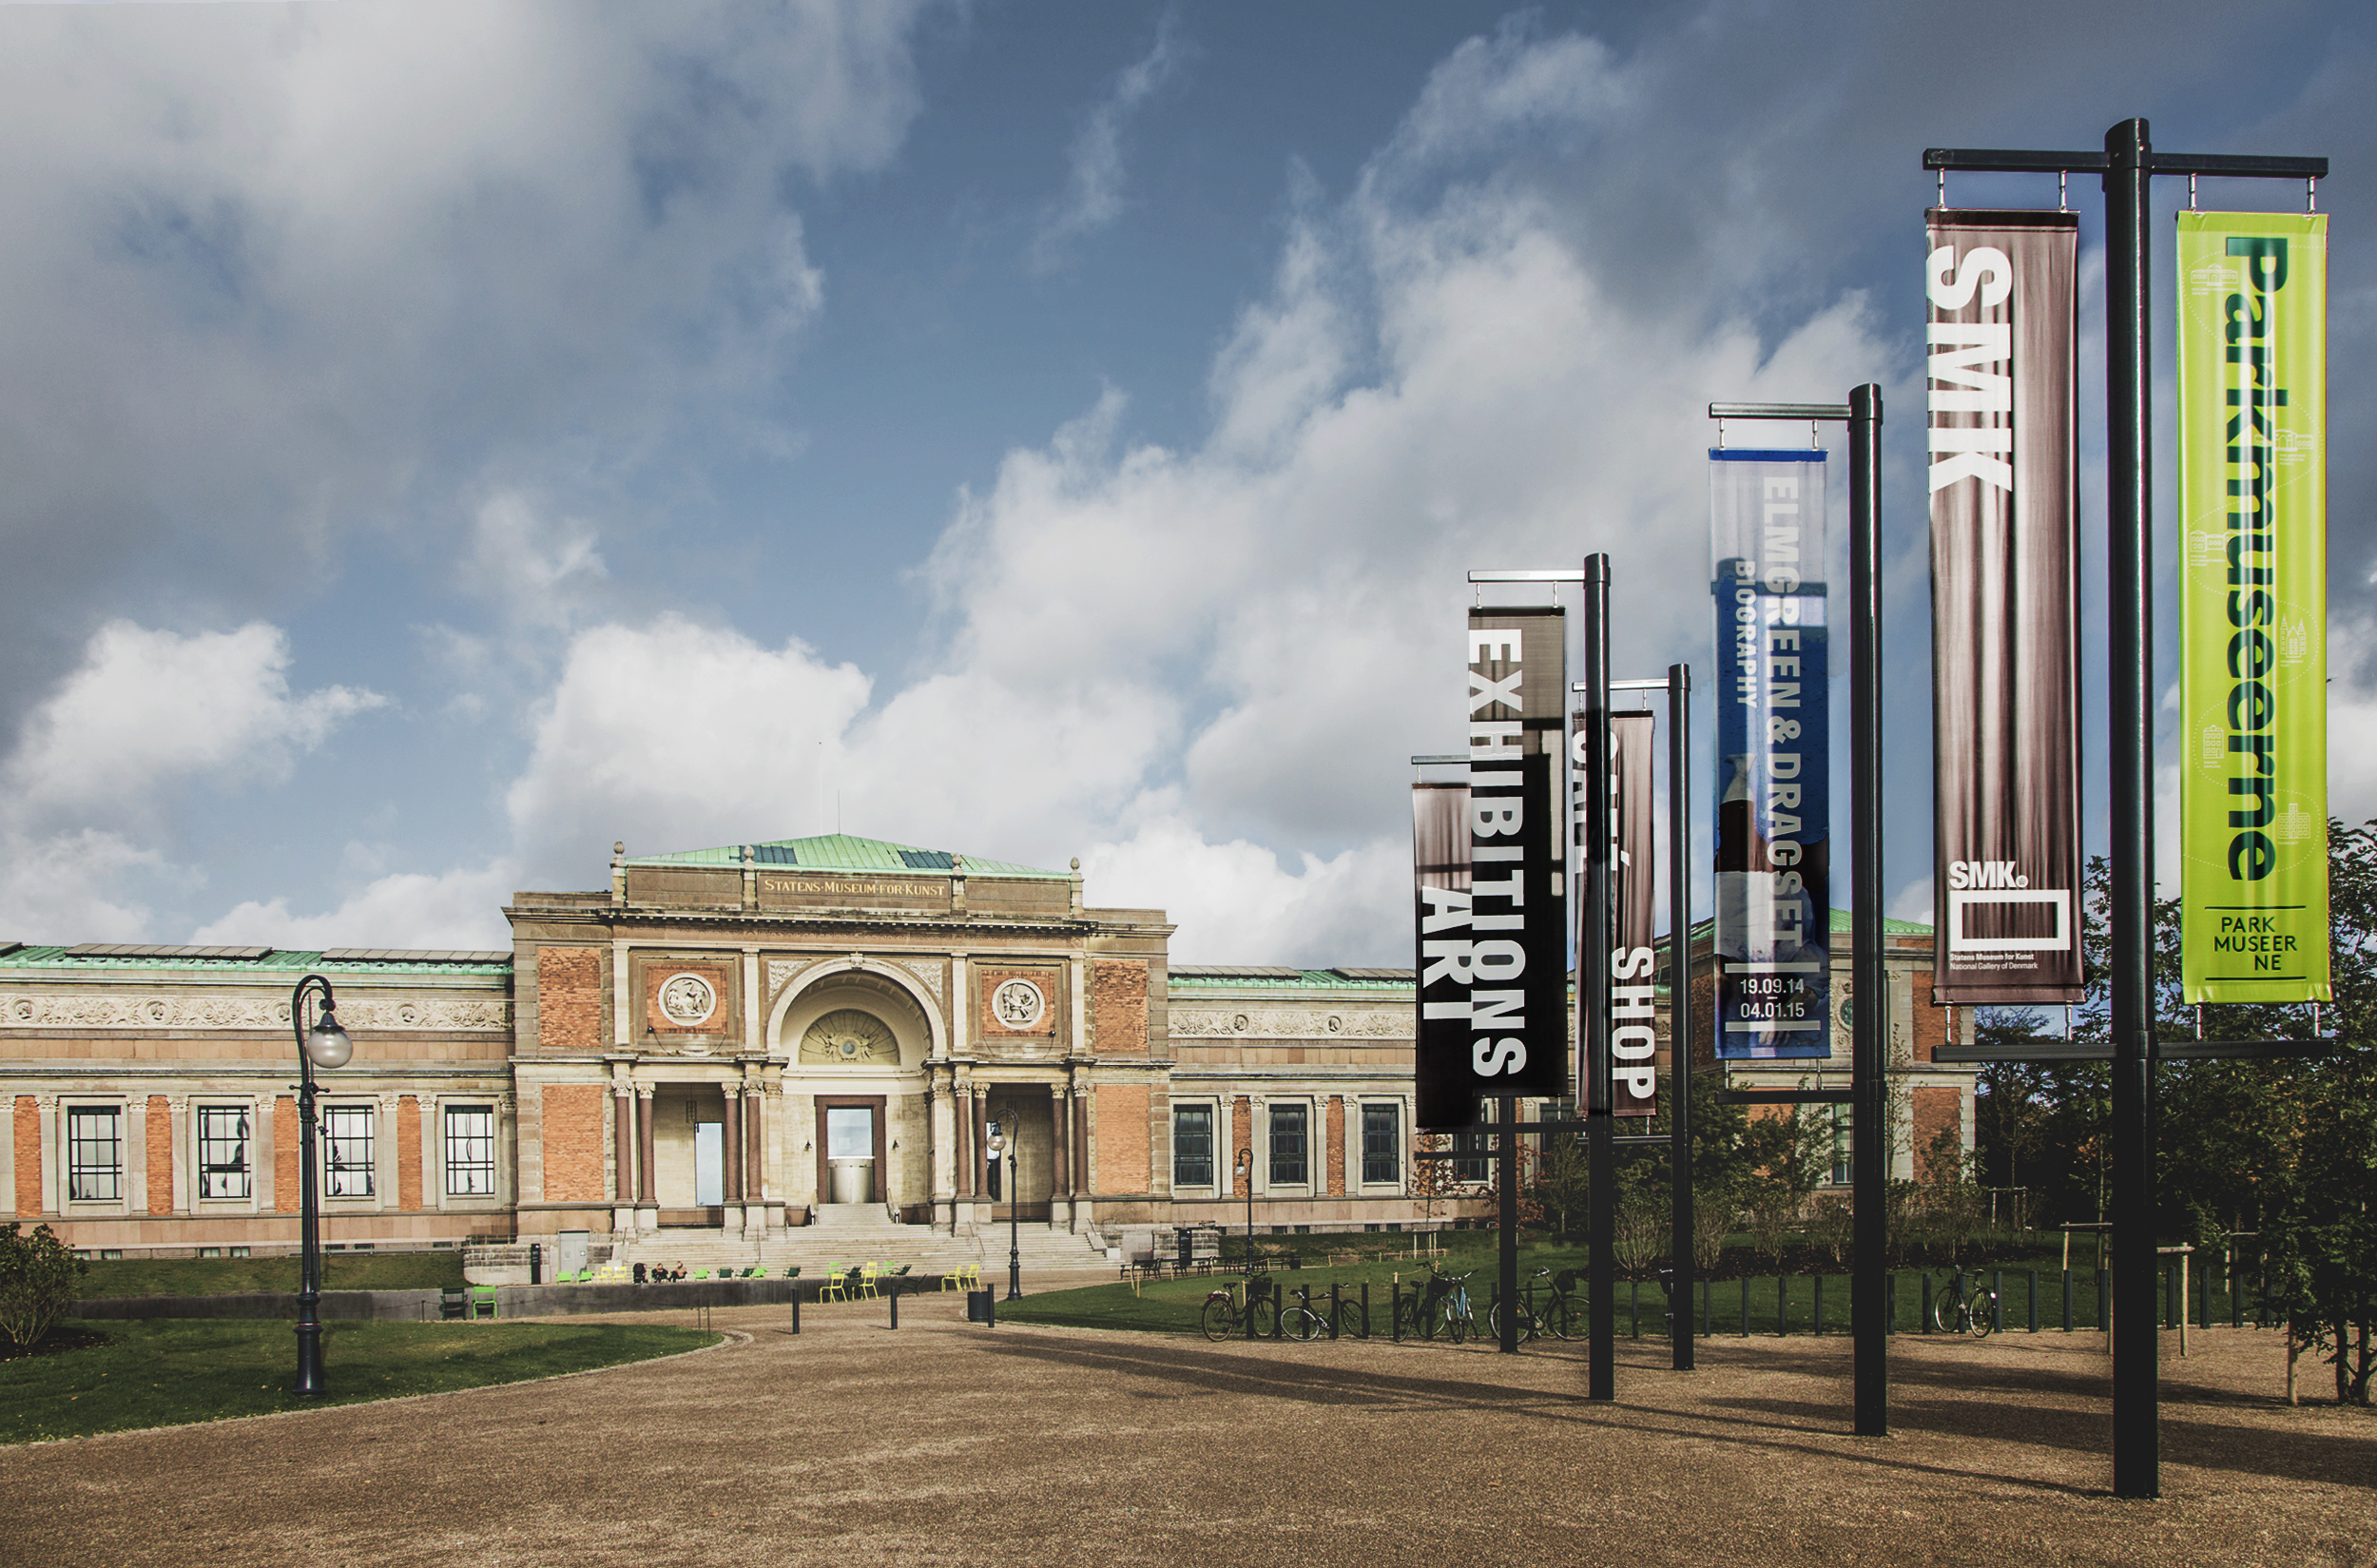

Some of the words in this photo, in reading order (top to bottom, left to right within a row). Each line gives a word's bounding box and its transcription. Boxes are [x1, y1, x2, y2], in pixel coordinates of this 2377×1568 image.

[1926, 244, 2013, 493] SMK
[2225, 237, 2289, 881] Parkmuseerne
[1764, 476, 1802, 707] ELMGREEN
[1735, 560, 1758, 708] BIOGRAPHY
[1766, 715, 1803, 745] &
[1469, 629, 1527, 1077] EXHIBITIONS
[1767, 753, 1804, 947] DRAGSET
[824, 881, 876, 894] MUSEUM
[905, 883, 945, 896] KUNST
[2221, 916, 2276, 933] PARK
[2213, 935, 2298, 952] MUSEER
[1949, 953, 1976, 961] Statens
[1976, 953, 2004, 961] Museum
[1978, 962, 2000, 971] Gallery
[2253, 954, 2282, 971] NE
[1739, 978, 1805, 995] 19.09.14
[1740, 1001, 1805, 1018] 04.01.15
[1612, 946, 1656, 1099] SHOP
